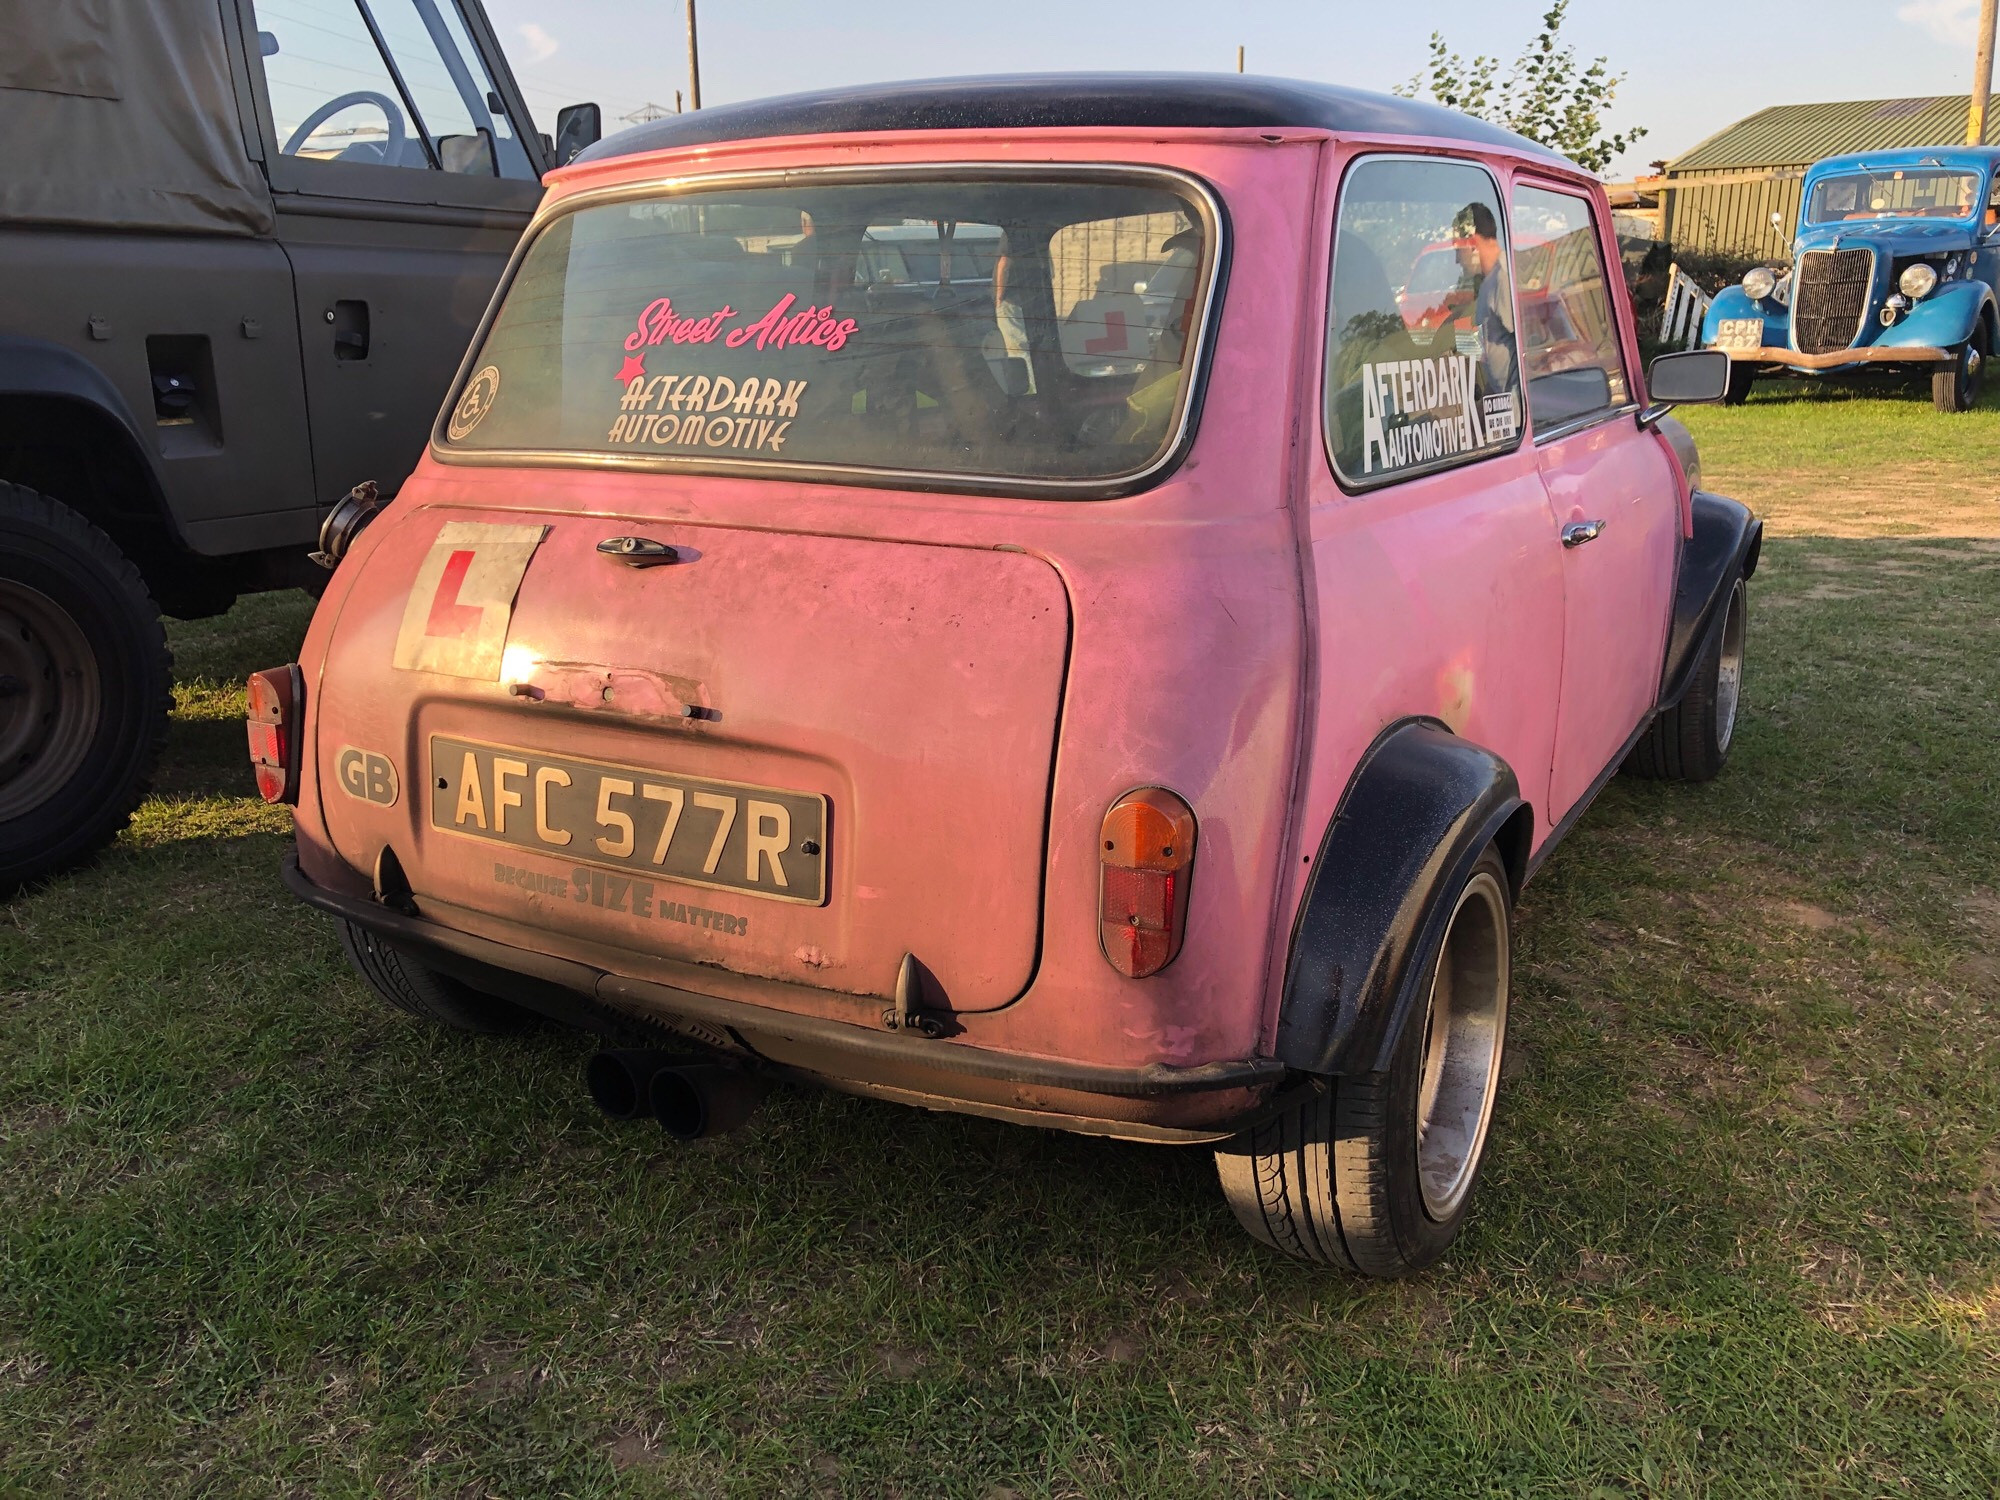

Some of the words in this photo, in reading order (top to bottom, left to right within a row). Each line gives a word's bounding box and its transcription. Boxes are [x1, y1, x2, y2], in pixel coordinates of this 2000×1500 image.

[624, 298, 738, 351] Street
[725, 293, 859, 351] Antics
[1723, 320, 1759, 335] CPH
[620, 375, 807, 417] AFTERDARK
[1363, 355, 1485, 473] AFTERDARK
[608, 414, 793, 451] AUTOMOTIVE
[1388, 416, 1468, 468] AUTOMOTIVE
[424, 550, 484, 640] L
[340, 749, 393, 804] GB
[455, 752, 572, 846] AFC
[595, 776, 791, 887] 577R
[494, 863, 568, 898] BECAUSE
[570, 867, 655, 919] SIZE
[659, 900, 748, 937] MATTERS
